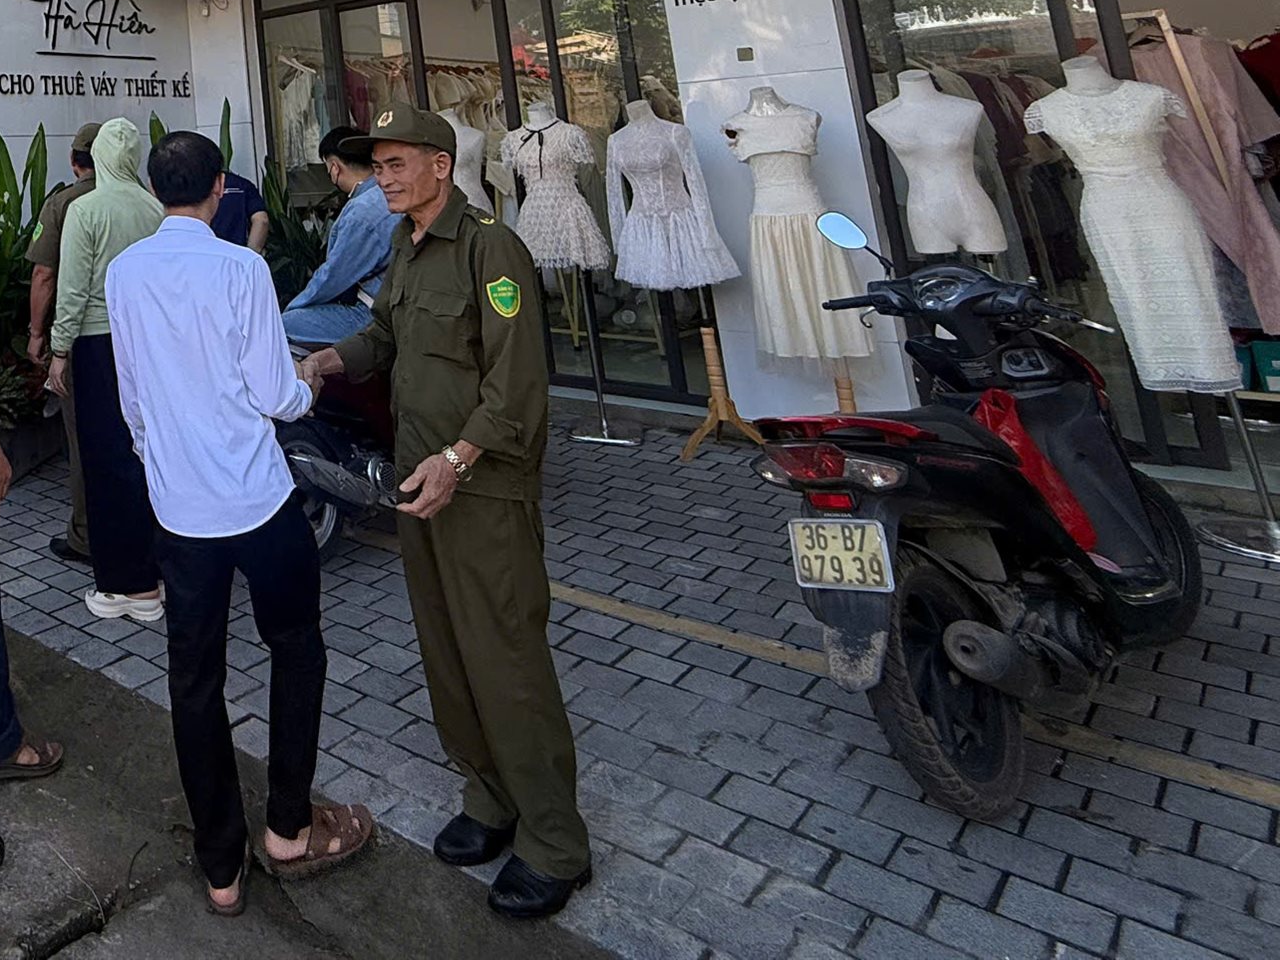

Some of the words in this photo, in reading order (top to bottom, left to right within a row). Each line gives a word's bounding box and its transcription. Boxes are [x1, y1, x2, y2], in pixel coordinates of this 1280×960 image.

[40, 72, 86, 96] THUÊ
[91, 70, 118, 97] VÁY
[124, 70, 168, 98] THIẾT
[172, 71, 191, 99] KẾ
[802, 524, 867, 553] 36-B7
[801, 554, 885, 585] 979.39
